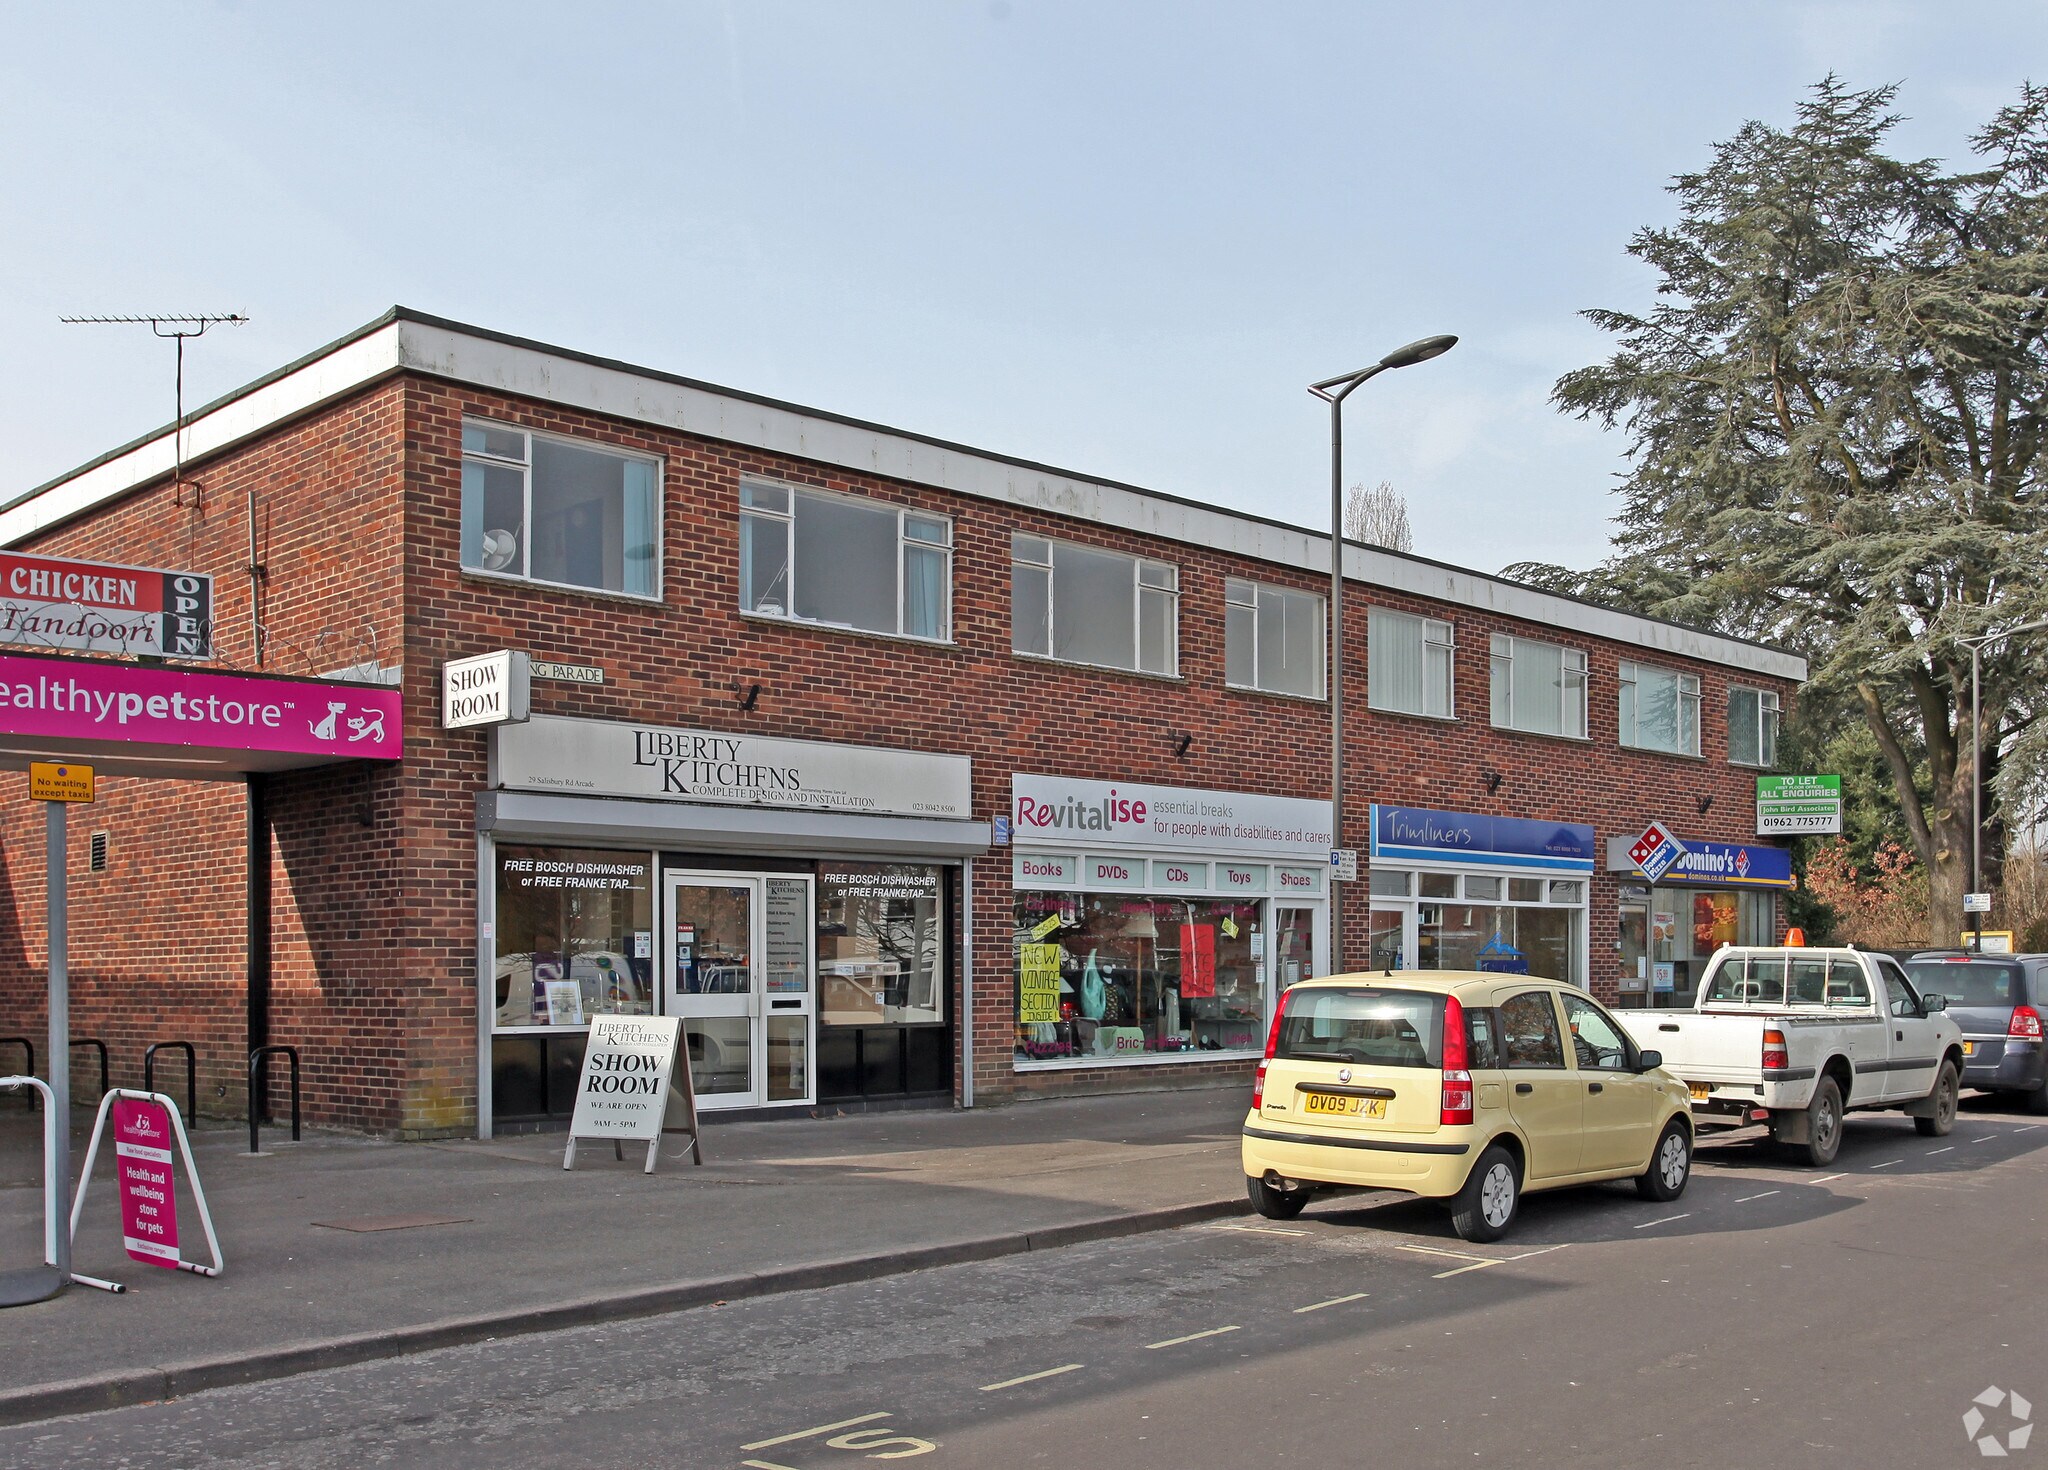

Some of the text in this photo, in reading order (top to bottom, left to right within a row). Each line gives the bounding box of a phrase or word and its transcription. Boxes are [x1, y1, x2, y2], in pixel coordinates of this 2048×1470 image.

[10, 567, 137, 606] CHICKEN
[173, 577, 200, 653] OPEN
[0, 607, 155, 643] Tandoori
[451, 664, 500, 692] SHOW
[553, 665, 601, 682] PARADE
[451, 692, 499, 719] ROOM
[632, 730, 743, 766] LIBERTY
[37, 778, 88, 790] No waiting
[528, 776, 595, 788] 29 Salisbury Rd Arcade
[660, 758, 801, 794] KITCHENS
[1781, 776, 1817, 785] TO LET
[34, 789, 91, 799] except taxis
[692, 785, 746, 798] COMPLETE
[749, 788, 785, 800] DESIGN
[787, 792, 808, 803] AND
[809, 794, 875, 808] INSTALLATION
[1760, 788, 1838, 798] ALL ENQUIRIES
[925, 804, 940, 812] 8042
[941, 805, 956, 813] 8500
[1017, 789, 1147, 831] Revitalise
[1153, 800, 1233, 818] essential breaks
[1386, 810, 1471, 845] Trimliners
[1763, 817, 1832, 826] 01962 775777
[1154, 817, 1331, 844] for people with disabilities and carers
[1643, 842, 1671, 872] Domino's
[504, 860, 644, 876] FREE BOSCH DISHWASHER
[1022, 860, 1062, 876] Books
[1097, 865, 1128, 880] DVDs
[1166, 868, 1189, 882] CDs
[1649, 858, 1667, 878] Pizza
[521, 877, 533, 887] or
[534, 876, 562, 887] FREE
[565, 877, 607, 889] FRANKE
[609, 878, 629, 889] TAP
[824, 873, 936, 886] FREE BOSCH DISHWASHER
[1227, 870, 1251, 885] Toys
[1280, 872, 1311, 886] Shoes
[771, 887, 805, 895] KITCHENS
[837, 887, 924, 898] or FREE FRANKE TAP
[1023, 946, 1058, 965] NEW
[1022, 970, 1059, 990] VINTAGE
[1021, 993, 1059, 1010] SECTION
[597, 1023, 645, 1036] LIBERTY
[606, 1032, 669, 1046] KITCHENS
[1225, 1032, 1252, 1044] Linen
[1025, 1040, 1072, 1053] Puzzles
[589, 1053, 664, 1072] SHOW
[585, 1075, 660, 1095] ROOM
[591, 1101, 648, 1110] WE ARE OPEN
[1310, 1095, 1379, 1114] OV09 JZK
[127, 1166, 165, 1184] Health and
[130, 1185, 165, 1204] wellbeing
[139, 1204, 158, 1216] store
[136, 1218, 163, 1234] for pets
[826, 1428, 935, 1459] S
